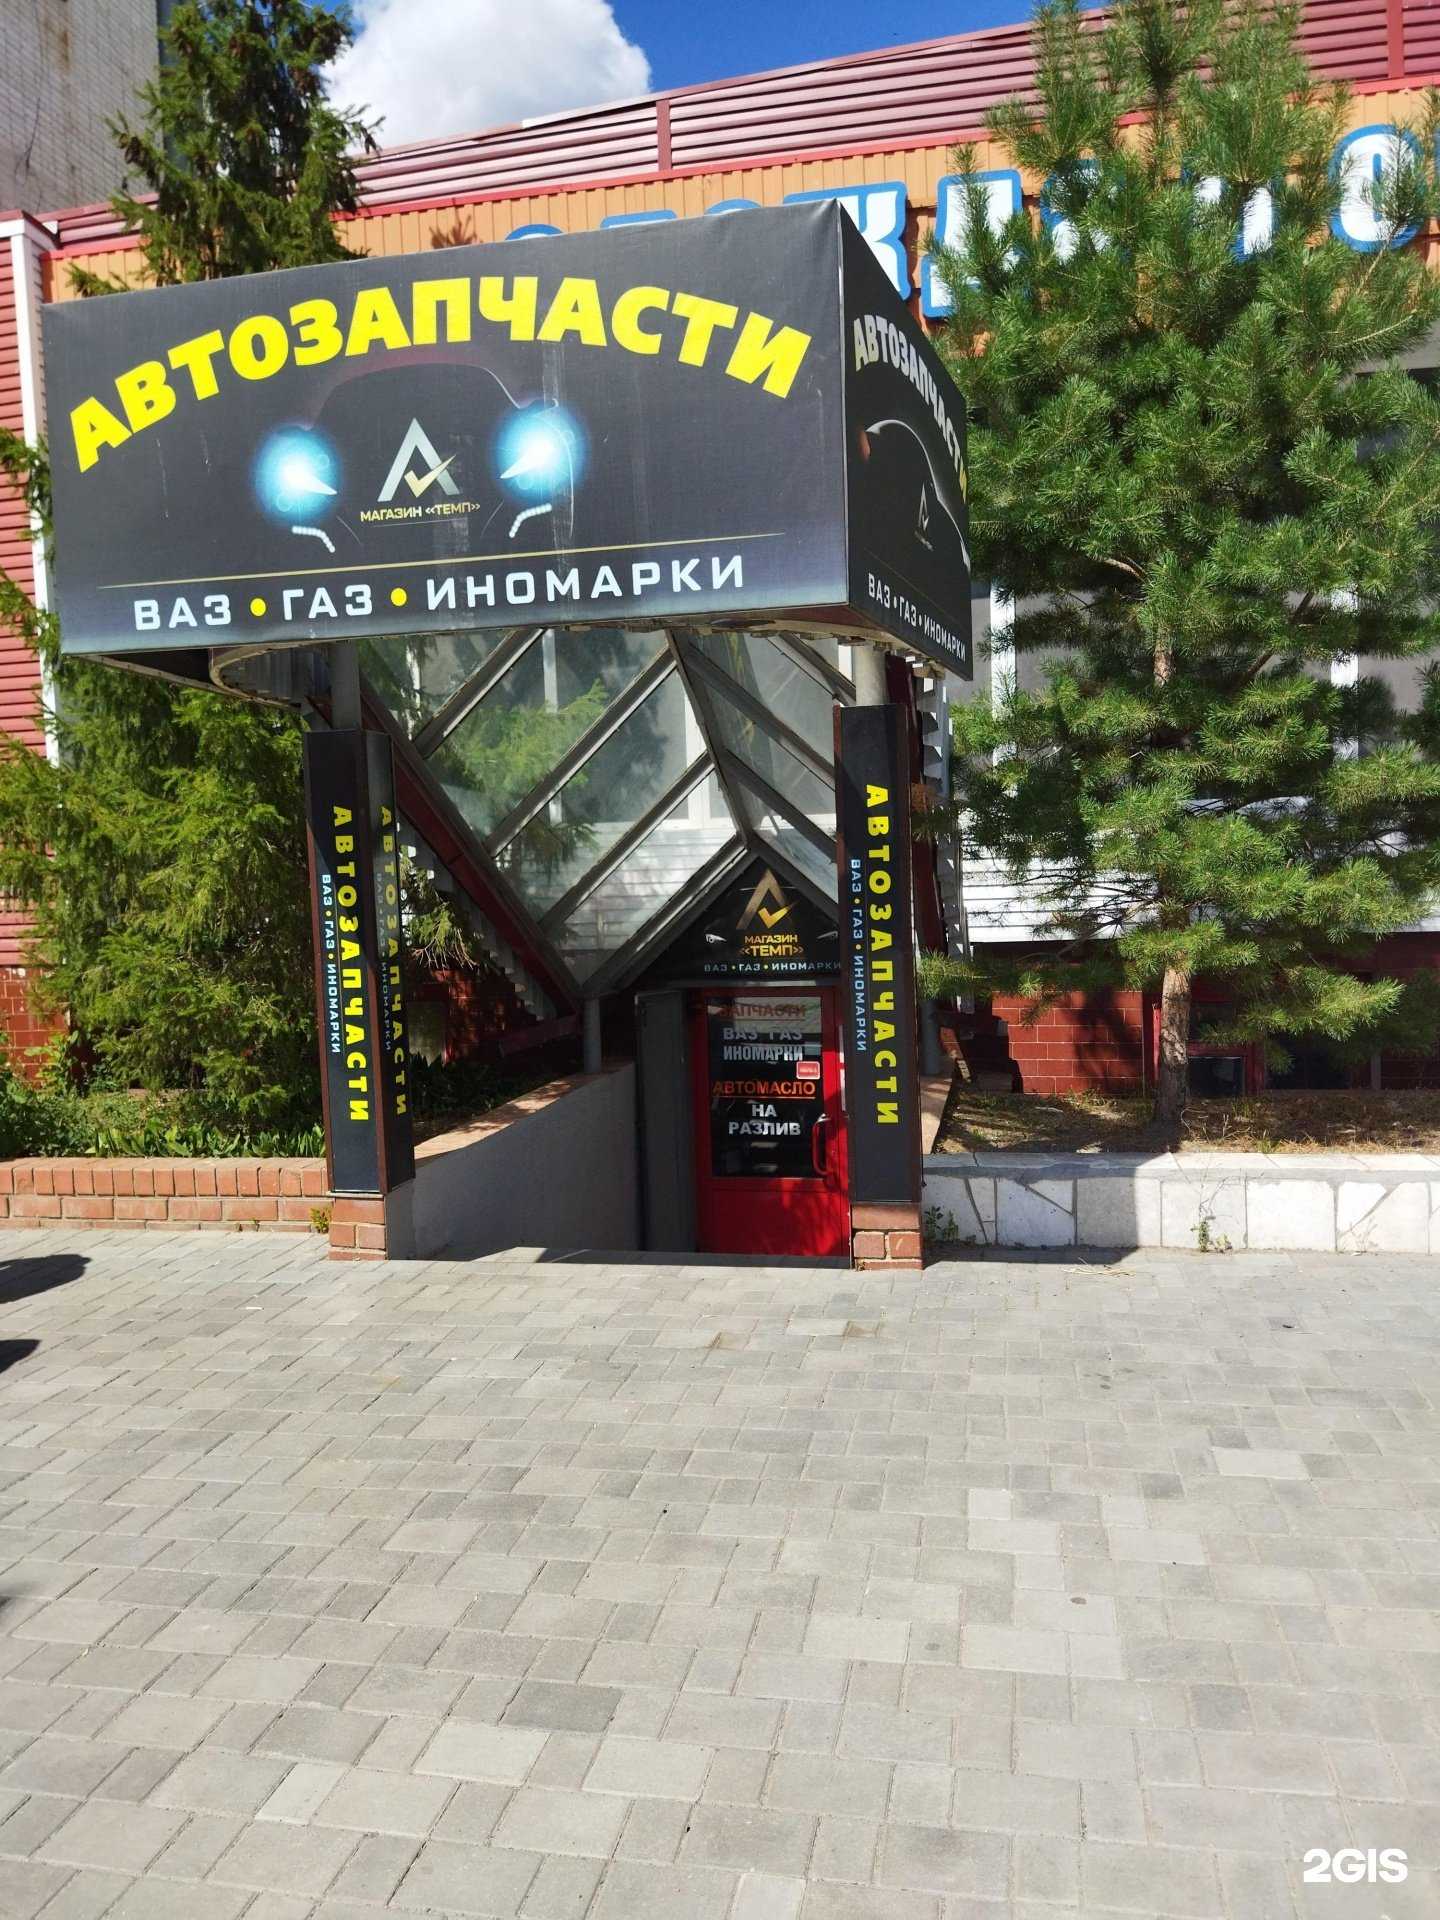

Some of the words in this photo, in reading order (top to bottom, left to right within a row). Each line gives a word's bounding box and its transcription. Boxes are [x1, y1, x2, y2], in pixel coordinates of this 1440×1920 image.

[70, 276, 811, 473] АВТОЗАПЧАСТИ
[853, 314, 967, 504] АВТОЗАПЧАСТИ
[360, 506, 422, 522] МАГАЗИН
[134, 594, 231, 631] ВАЗ
[282, 584, 373, 621] ГАЗ
[426, 554, 744, 610] ИНОМАРКИ
[868, 572, 891, 609] ВАЗ
[899, 596, 917, 627] ГАЗ
[924, 614, 966, 662] ИНОМАРКИ
[322, 874, 332, 906] ВАЗ
[851, 859, 862, 893] ВАЗ
[325, 920, 335, 949] ГАЗ
[744, 934, 798, 944] МАГАЗИН
[852, 909, 864, 940] ГАЗ
[333, 806, 369, 1121] АВТОЗАПЧАСТИ
[380, 806, 407, 1115] АВТОЗАПЧАСТИ
[738, 963, 760, 971] ГАЗ
[865, 784, 900, 1123] АВТОЗАПЧАСТИ
[327, 963, 341, 1053] ИНОМАРКИ
[853, 955, 867, 1051] ИНОМАРКИ
[723, 1045, 803, 1061] ИНОМАРКИ
[713, 1081, 816, 1095] АВТОМАСЛО
[752, 1104, 777, 1117] НА
[728, 1121, 801, 1135] РАЗЛИВ
